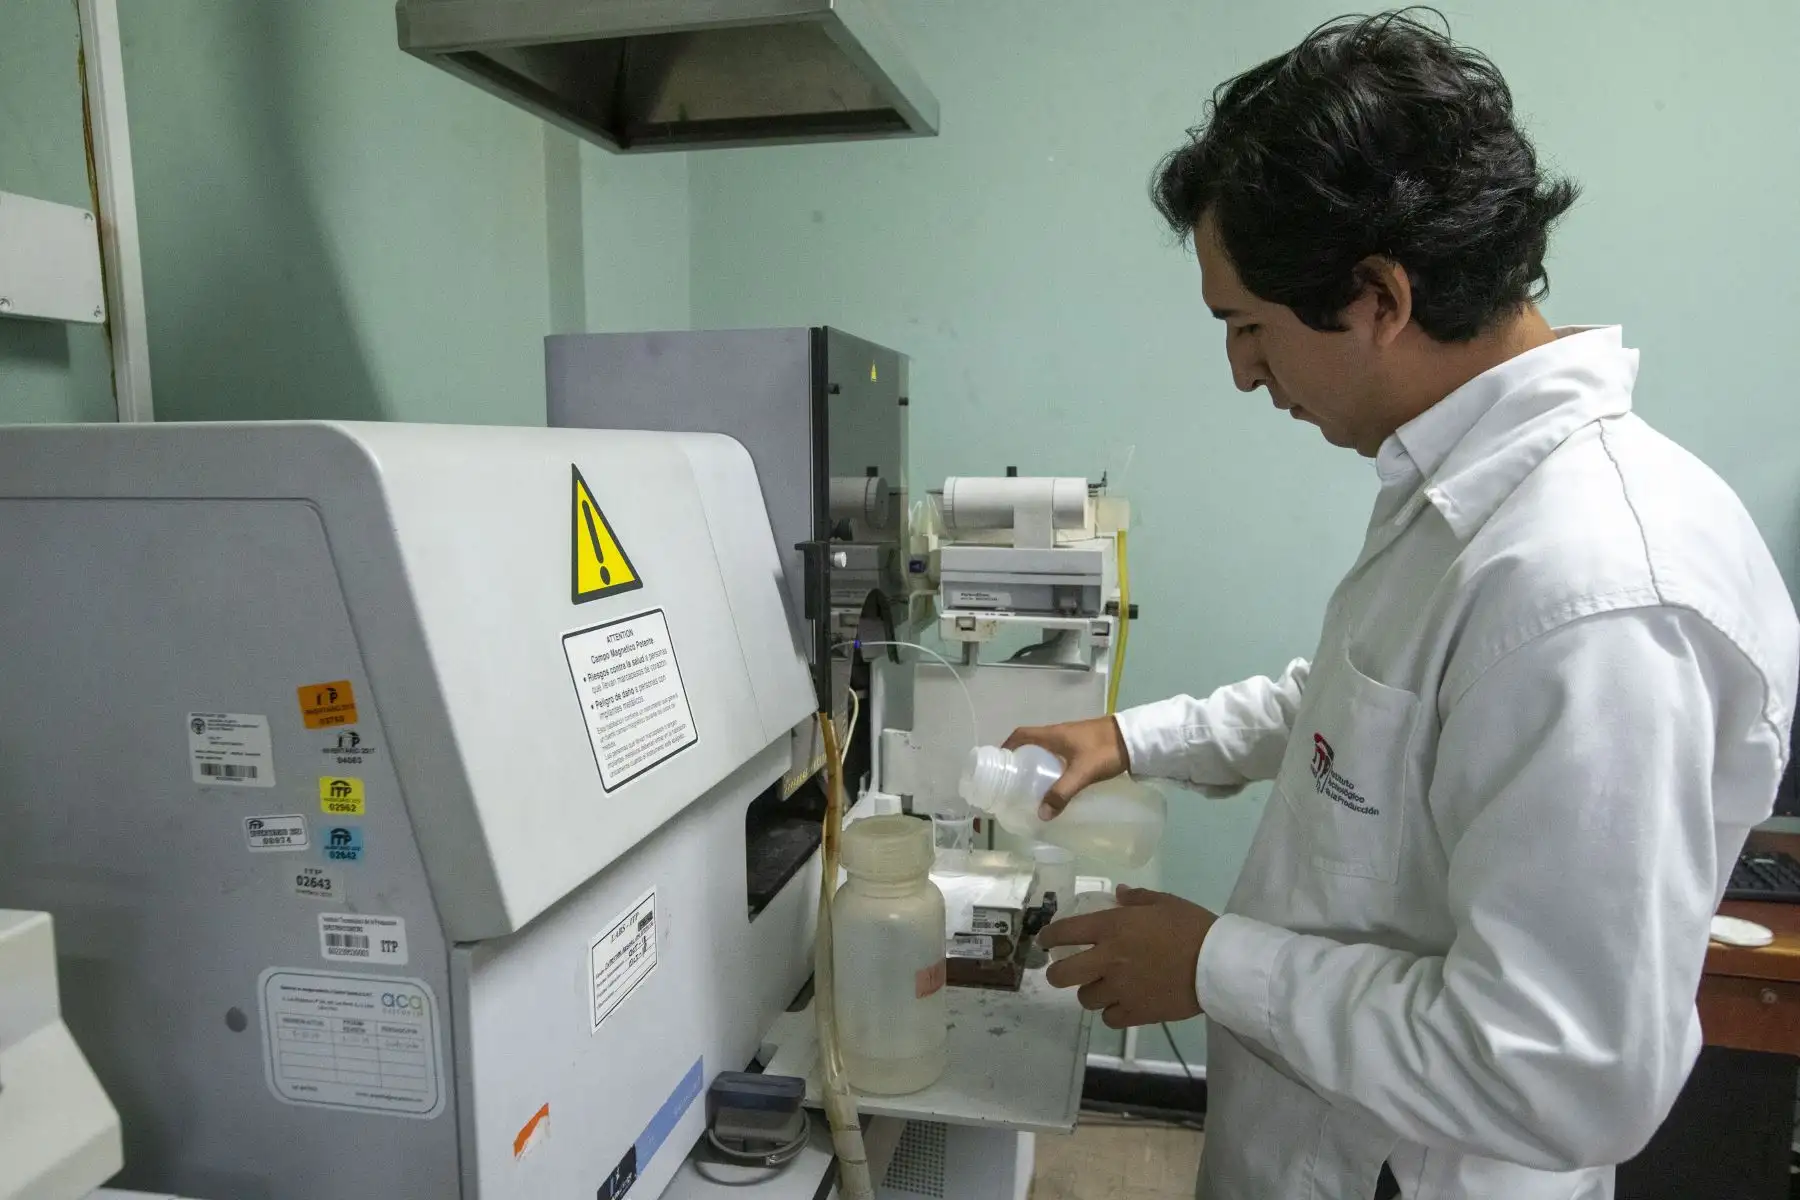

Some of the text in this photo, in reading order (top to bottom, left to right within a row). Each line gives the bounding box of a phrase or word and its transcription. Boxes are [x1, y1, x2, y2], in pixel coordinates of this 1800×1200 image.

[606, 629, 634, 643] ATTENTION
[591, 651, 610, 664] Campo
[636, 637, 654, 649] Potente
[587, 669, 610, 682] Riesgos
[609, 663, 627, 675] contra
[631, 654, 645, 666] salud
[648, 648, 668, 661] personas
[595, 696, 615, 709] Peligro
[615, 692, 622, 701] de
[639, 678, 659, 692] personas
[658, 674, 667, 683] con
[331, 784, 352, 797] ITP
[1338, 796, 1380, 816] Producción
[331, 832, 352, 845] ITP
[296, 875, 331, 890] 02643
[381, 940, 398, 952] ITP
